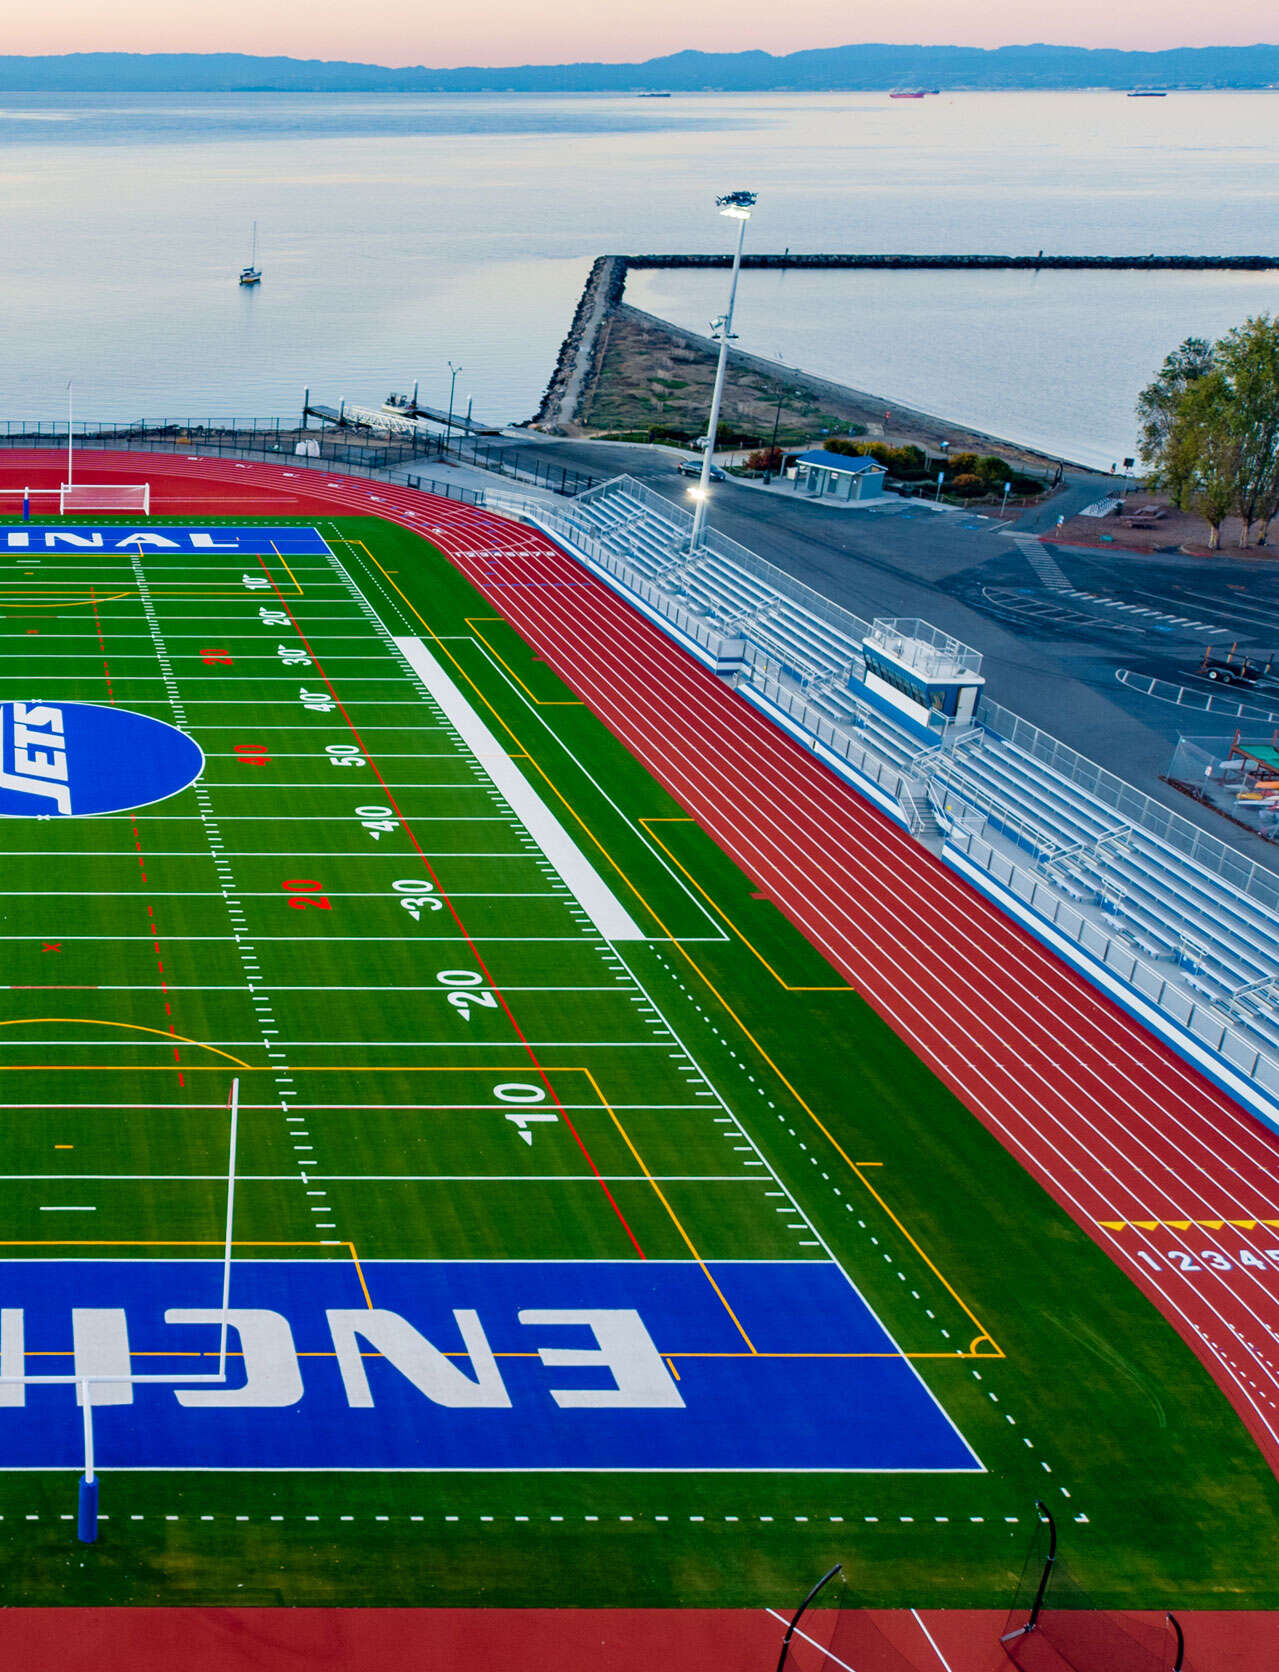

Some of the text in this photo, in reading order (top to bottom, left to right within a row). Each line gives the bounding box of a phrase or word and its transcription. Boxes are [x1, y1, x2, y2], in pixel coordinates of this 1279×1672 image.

[242, 578, 272, 590] 10
[258, 611, 292, 626] 20
[199, 649, 233, 665] 20
[277, 649, 312, 666] 30
[299, 693, 336, 712] 40
[234, 744, 272, 766] 40
[325, 744, 366, 767] 50
[355, 806, 400, 832] 40
[281, 879, 332, 910] 20
[392, 879, 444, 911] 30
[436, 970, 498, 1008] 20
[493, 1083, 559, 1128] 10
[1137, 1250, 1162, 1271] 1
[1167, 1250, 1202, 1271] 2
[1200, 1250, 1233, 1271] 3
[1239, 1249, 1267, 1270] 4
